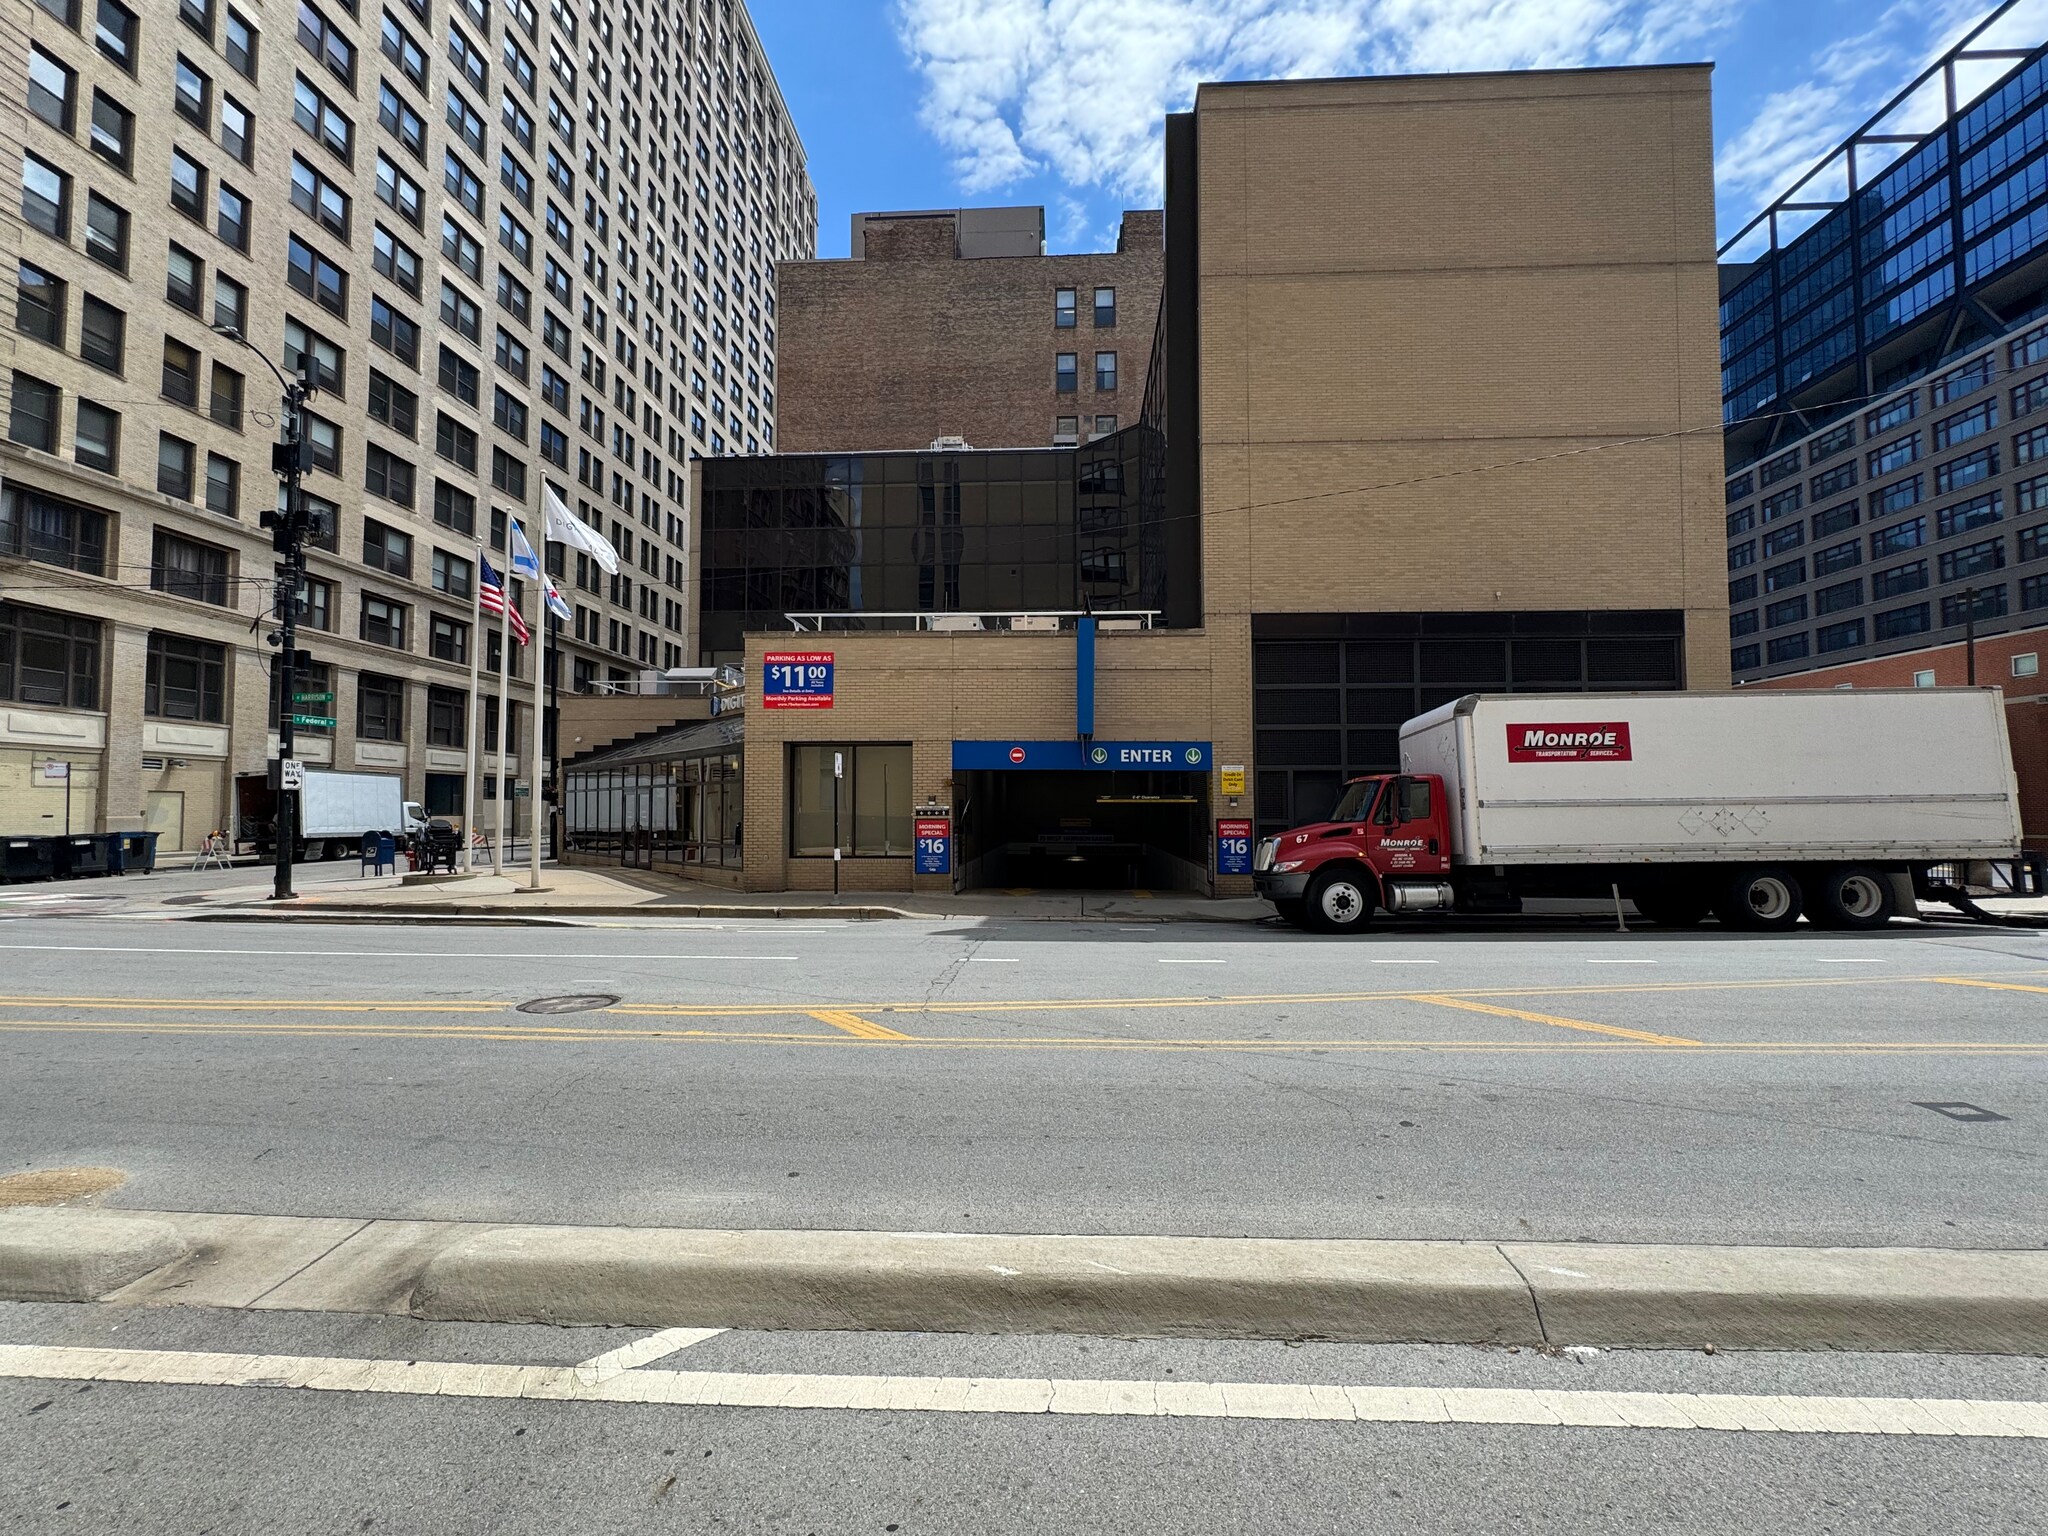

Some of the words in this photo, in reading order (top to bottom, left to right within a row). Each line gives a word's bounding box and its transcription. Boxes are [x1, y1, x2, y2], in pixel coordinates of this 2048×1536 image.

[302, 716, 327, 725] Federal
[1524, 730, 1616, 747] MONROE
[1120, 749, 1172, 763] ENTER
[1296, 834, 1308, 843] 67
[920, 839, 944, 854] $16
[1222, 839, 1247, 854] $16
